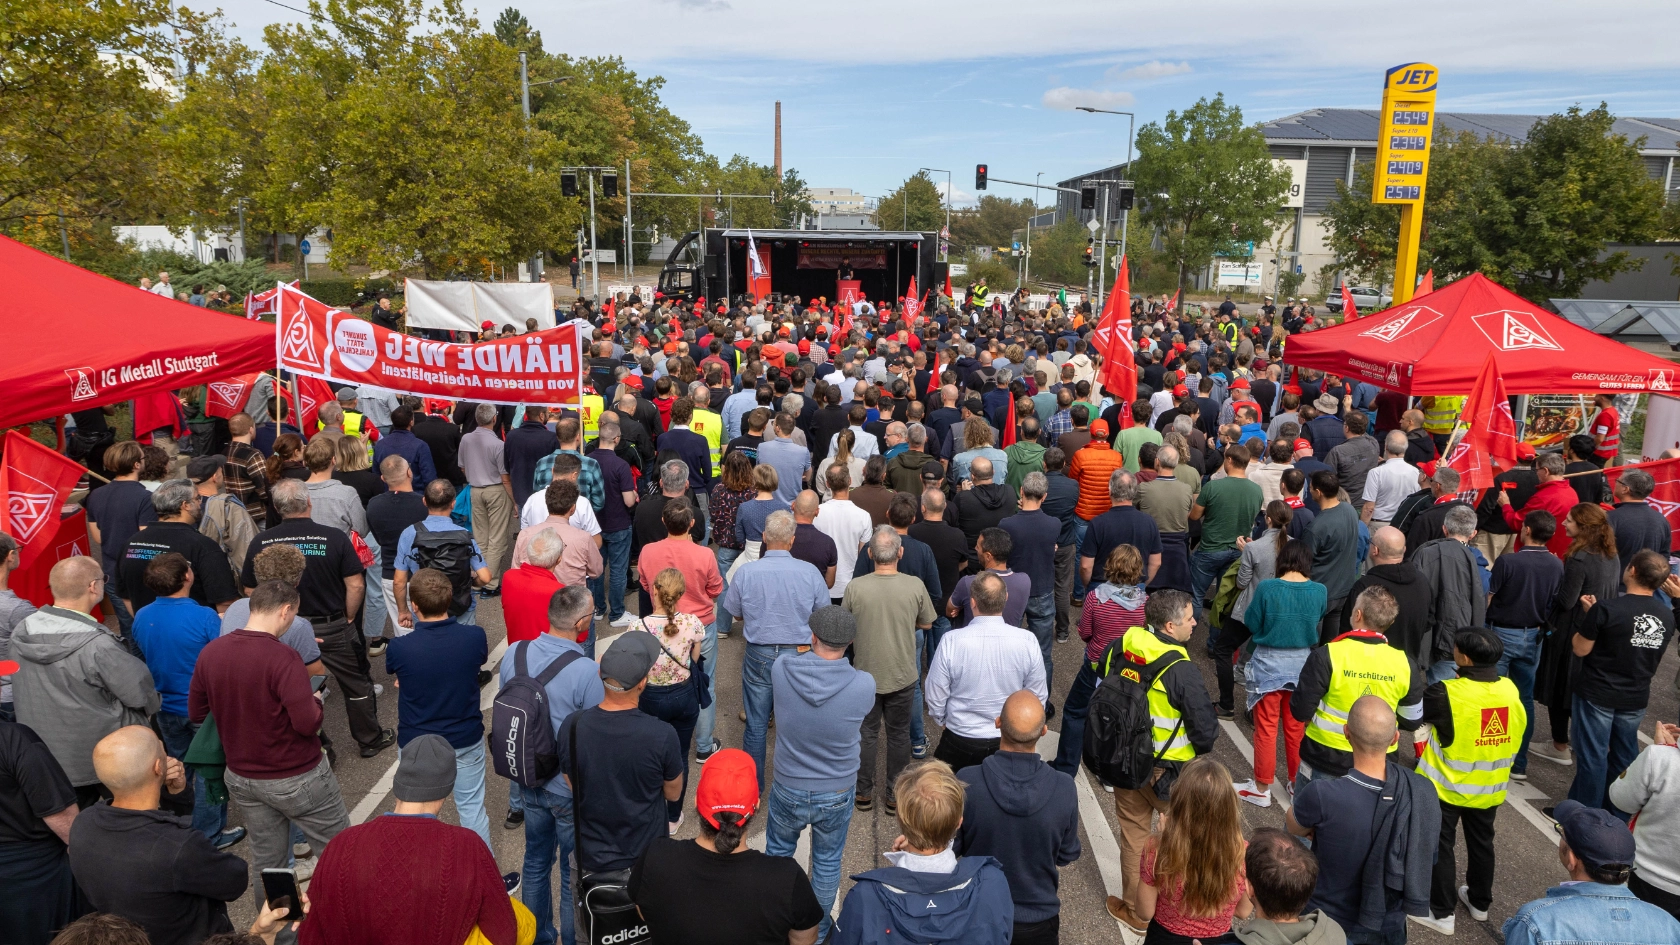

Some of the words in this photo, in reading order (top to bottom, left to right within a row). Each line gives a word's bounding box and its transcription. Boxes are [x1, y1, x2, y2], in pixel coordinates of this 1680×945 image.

[1396, 70, 1434, 84] JET
[1394, 111, 1427, 125] 2.549
[1391, 136, 1424, 150] 2.349
[1388, 161, 1421, 174] 2.409
[1386, 186, 1419, 199] 2.519
[101, 368, 117, 388] IG
[120, 359, 163, 383] Metall
[164, 351, 220, 375] Stuttgart
[1572, 372, 1618, 382] GEMEINSAM
[1618, 373, 1632, 382] FÜR
[1343, 669, 1357, 678] Wir
[1358, 671, 1396, 682] schützen!
[505, 715, 520, 777] adidas
[1474, 736, 1511, 747] Stuttgart
[601, 924, 650, 945] adida
